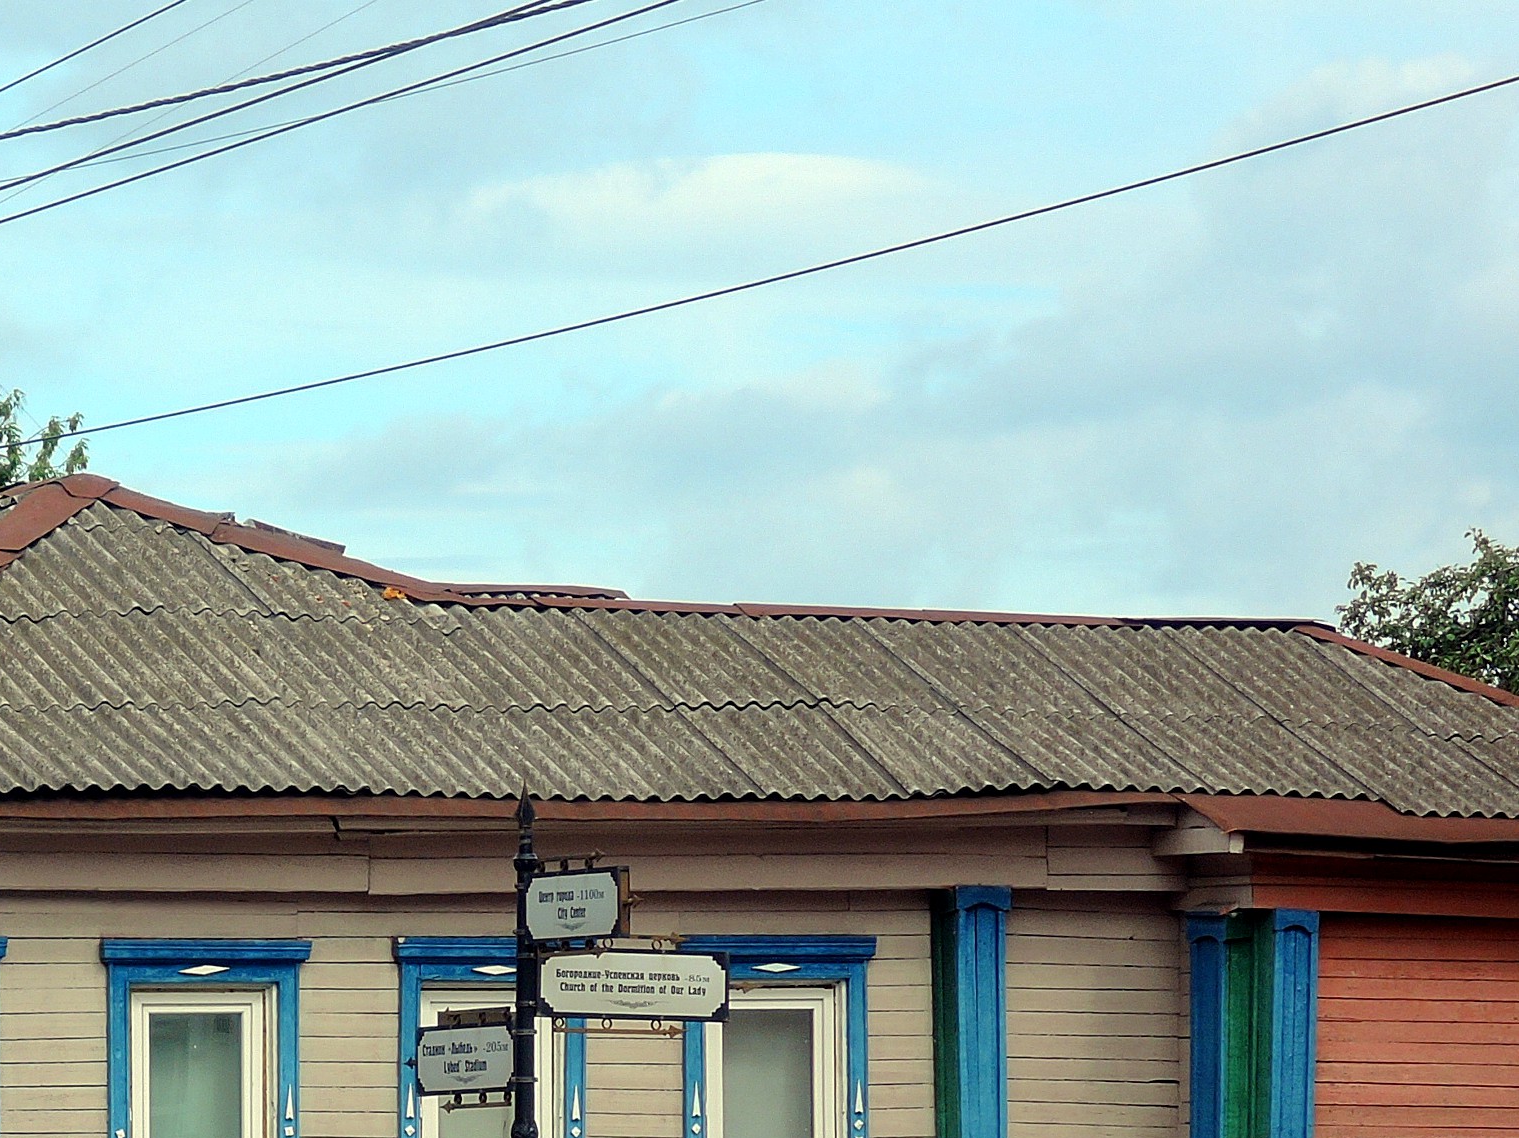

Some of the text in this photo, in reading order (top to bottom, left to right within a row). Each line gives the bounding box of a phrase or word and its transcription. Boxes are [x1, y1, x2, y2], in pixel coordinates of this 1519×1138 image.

[558, 906, 586, 920] City Center
[648, 972, 680, 982] церковь
[560, 982, 707, 996] Church of the Dormition of Our Lady
[422, 1044, 446, 1057] Стадион
[465, 1059, 488, 1073] Stadium
